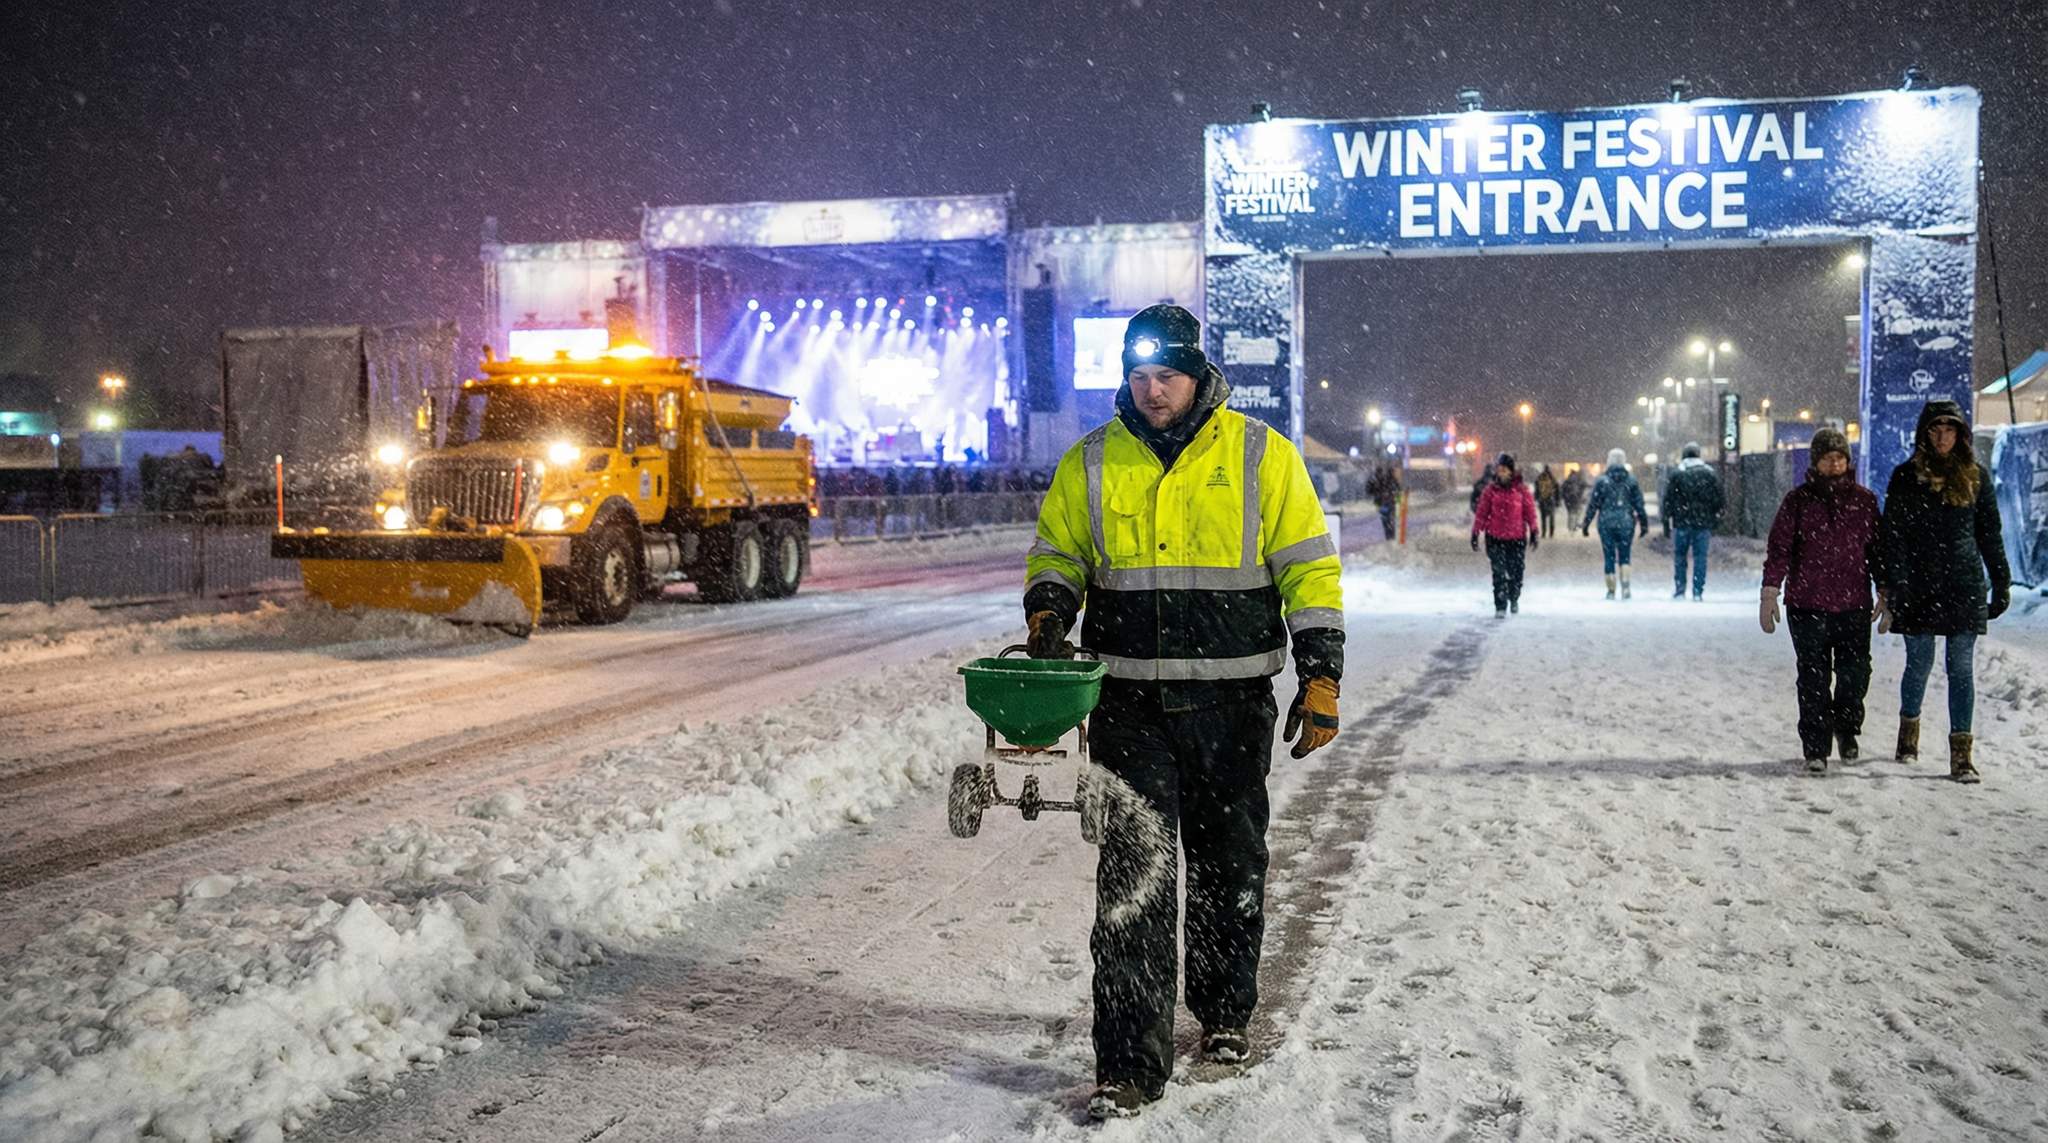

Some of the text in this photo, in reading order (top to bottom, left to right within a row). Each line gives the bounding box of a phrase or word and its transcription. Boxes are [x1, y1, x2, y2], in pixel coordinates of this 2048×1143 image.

[1332, 112, 1824, 179] WINTER FESTIVAL
[1225, 192, 1316, 215] FESTIVAL
[1230, 172, 1310, 195] WINTER
[1400, 170, 1748, 238] ENTRANCE
